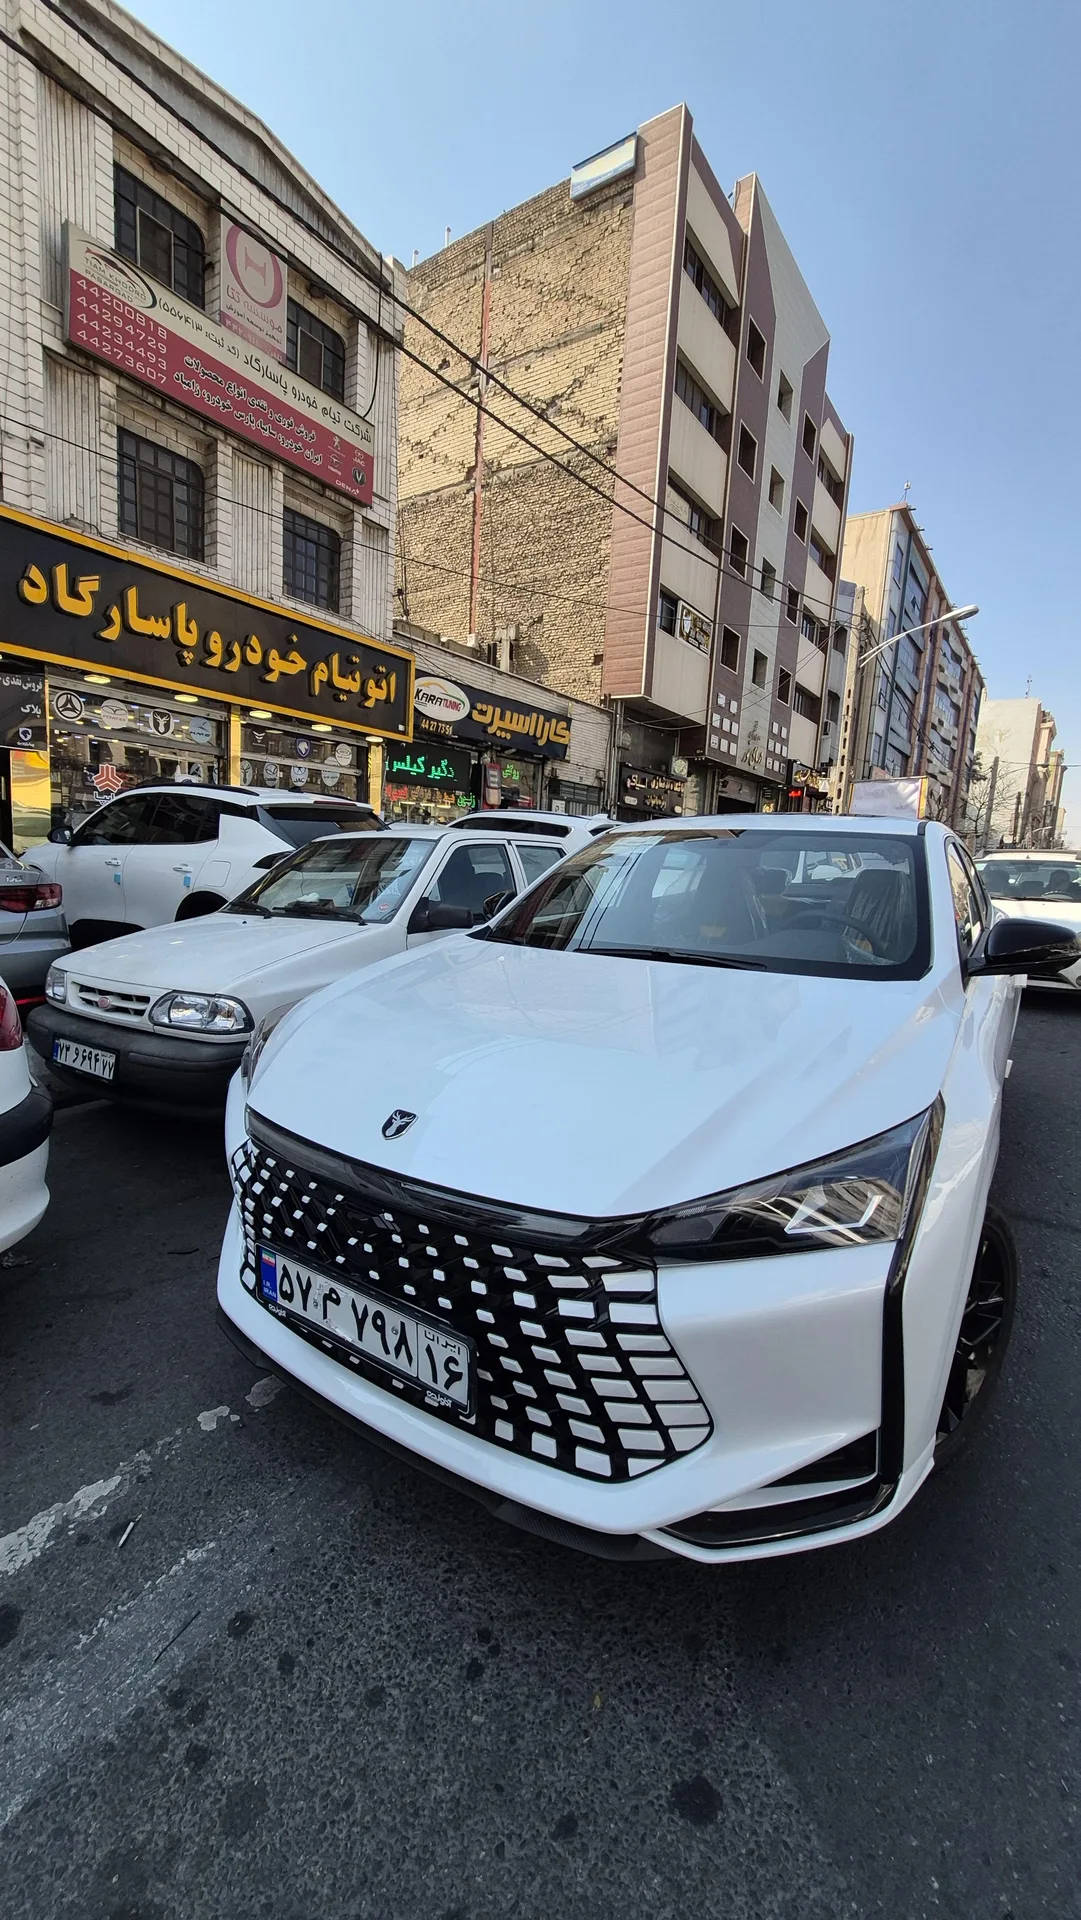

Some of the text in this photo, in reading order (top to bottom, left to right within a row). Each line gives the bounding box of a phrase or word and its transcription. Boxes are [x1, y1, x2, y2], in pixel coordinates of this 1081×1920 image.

[84, 256, 146, 301] TIAM KHODRO
[85, 269, 133, 303] PASARGAD
[77, 279, 167, 340] 44200818
[77, 296, 167, 354] 44294729
[77, 313, 167, 370] 44234493
[77, 330, 167, 385] 44273607
[173, 372, 201, 397] زامیاد
[244, 354, 288, 396] پاسارگاد
[184, 355, 316, 442] فروش فوری و نقدی انواع محصولات
[291, 386, 318, 410] خودرو
[233, 410, 256, 430] پارس
[321, 407, 341, 424] تیام
[343, 420, 372, 443] شرکت
[304, 448, 322, 465] ایران
[18, 561, 397, 708] اتو تیام خودرو پاسارگاد
[2, 675, 43, 693] فروش نقدی
[414, 688, 462, 712] KARA TUNING
[20, 704, 42, 719] پلاک
[471, 702, 537, 740] اسپرت
[263, 1287, 277, 1299] IRAN
[279, 1264, 414, 1368] ۵۷ م ۷۹۸
[424, 1329, 460, 1356] ایران
[425, 1343, 463, 1390] ۱۶
